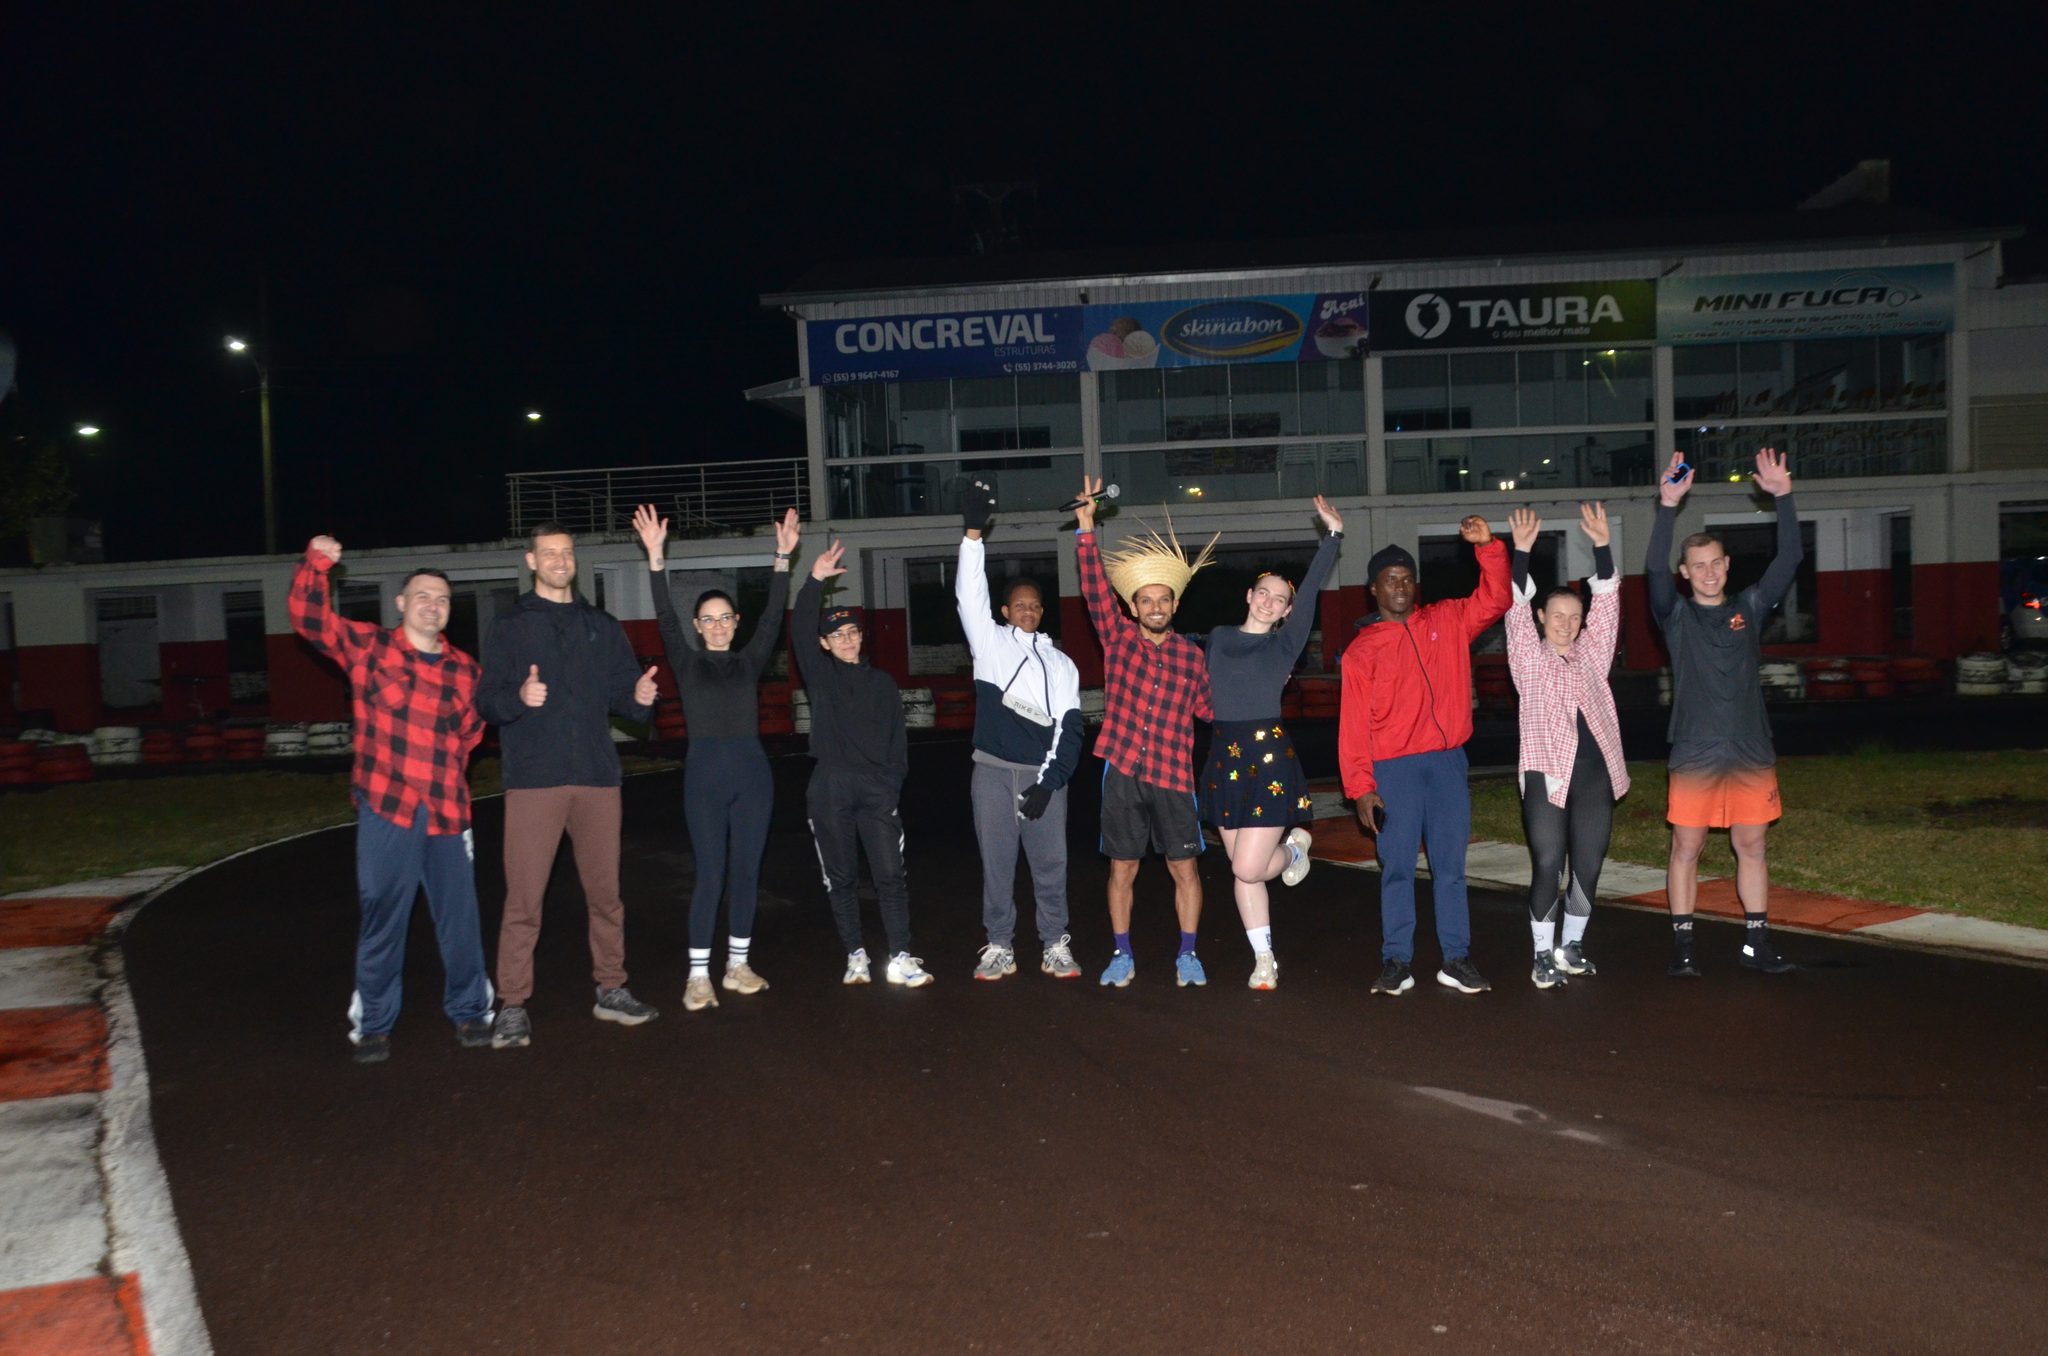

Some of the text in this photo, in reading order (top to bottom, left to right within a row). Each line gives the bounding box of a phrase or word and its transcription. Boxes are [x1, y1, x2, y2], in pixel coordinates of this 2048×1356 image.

[1693, 287, 1888, 312] MINI FUCA
[1458, 294, 1624, 328] TAURA
[835, 313, 1055, 354] CONCREVAL
[1180, 316, 1284, 337] skinabon
[1492, 326, 1591, 339] o seu melhor mate
[994, 344, 1056, 357] ESTRUTURAS
[1015, 360, 1077, 372] (55) 3744-3020
[833, 371, 849, 382] (55)
[850, 372, 856, 380] 9
